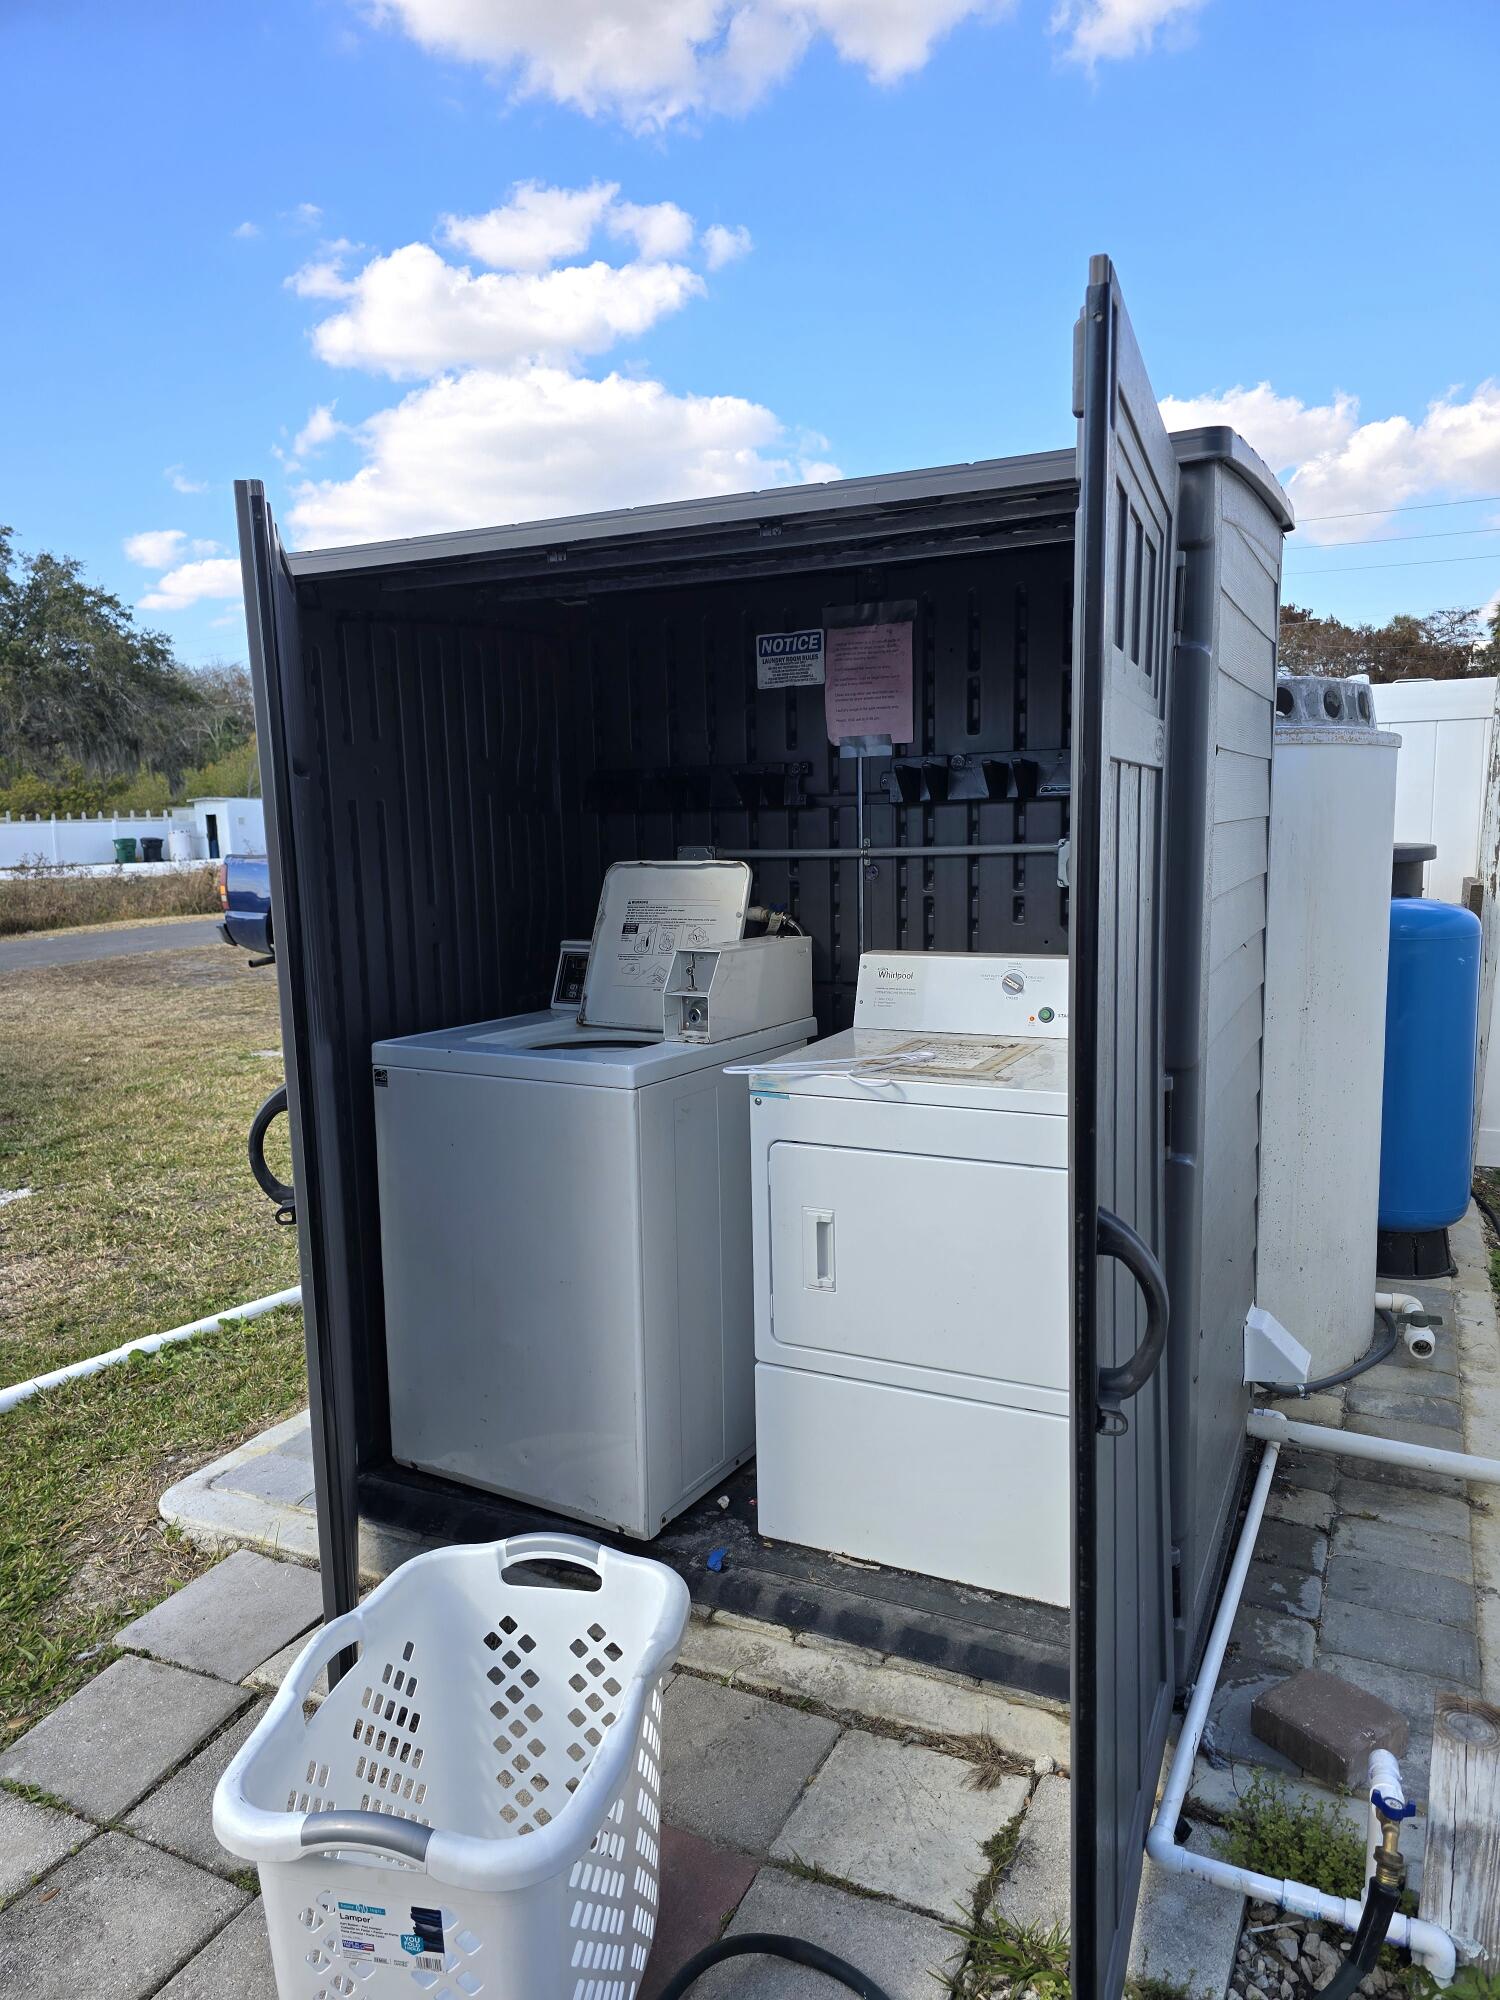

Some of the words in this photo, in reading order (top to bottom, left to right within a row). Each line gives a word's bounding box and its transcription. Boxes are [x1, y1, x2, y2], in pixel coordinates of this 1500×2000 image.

[762, 634, 820, 654] NOTICE
[762, 656, 786, 664] LAUNDRY
[878, 970, 914, 981] Whirlpool
[339, 1912, 371, 1923] Lamper
